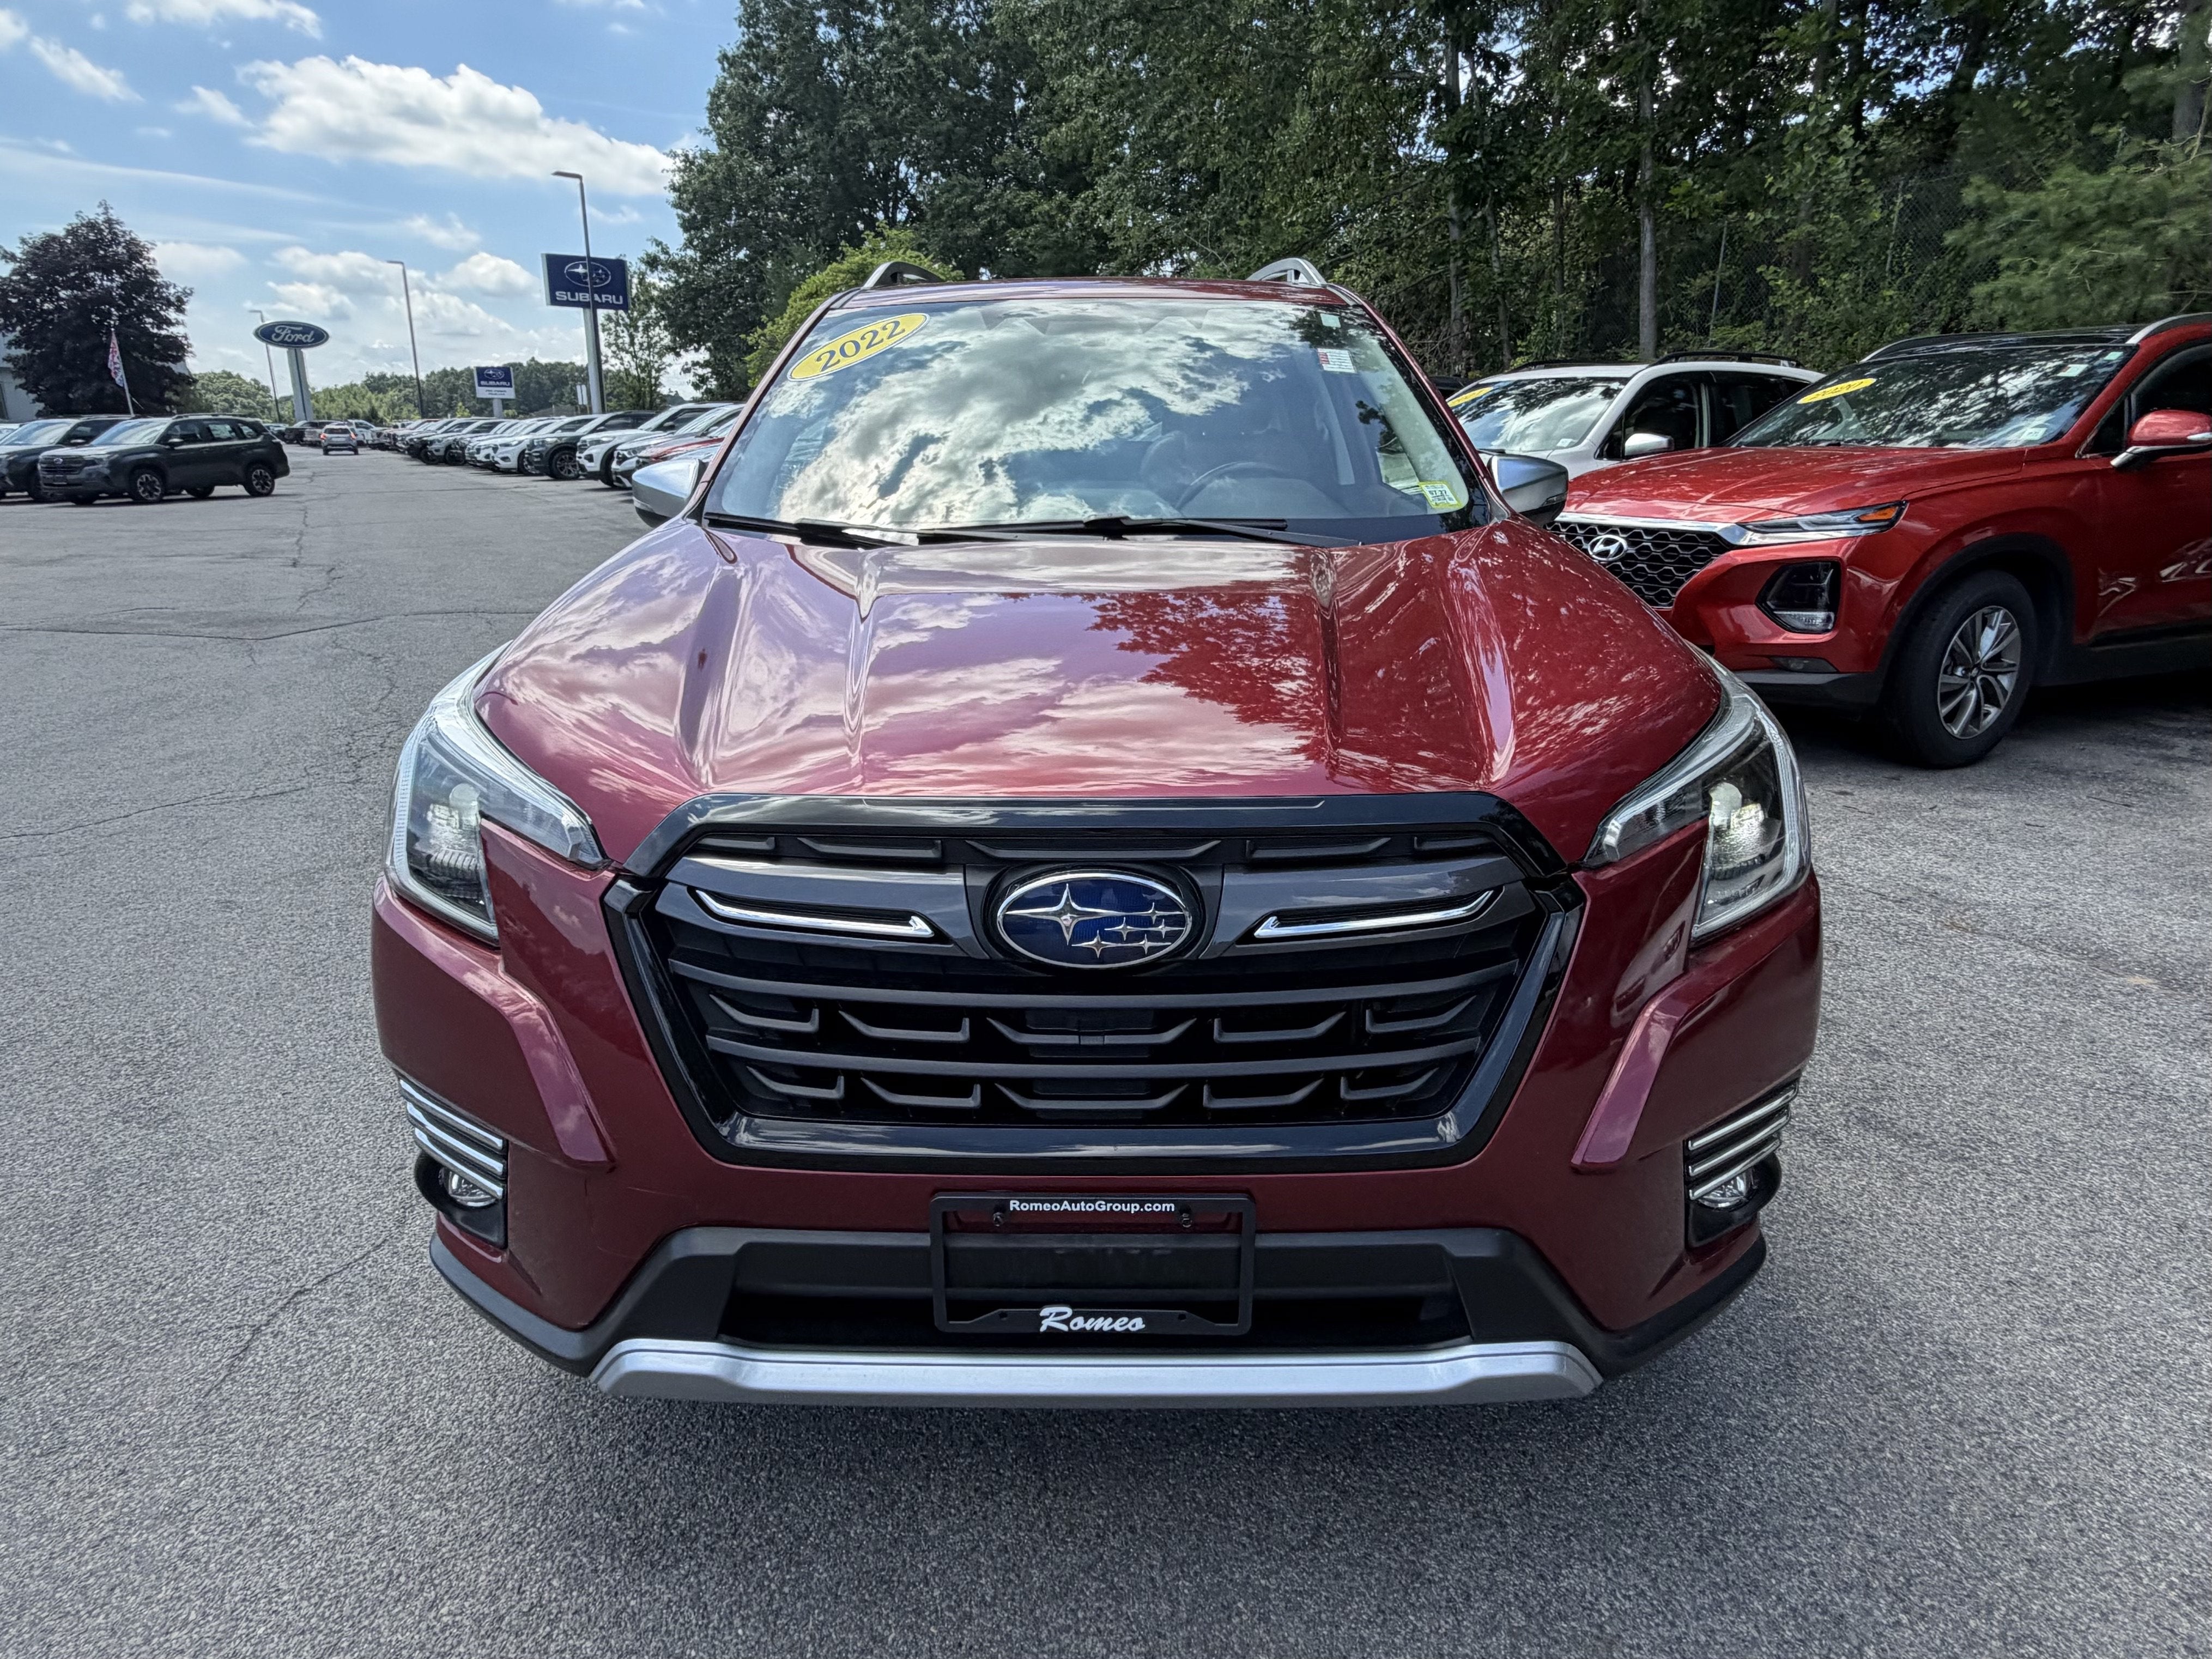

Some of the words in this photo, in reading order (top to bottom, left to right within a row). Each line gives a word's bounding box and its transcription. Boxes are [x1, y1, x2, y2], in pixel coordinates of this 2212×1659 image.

[556, 291, 623, 304] SUBARU
[271, 325, 314, 342] Ford
[816, 320, 905, 372] 2022
[1010, 1200, 1175, 1214] RomeoAutoGroup.com
[1039, 1306, 1146, 1332] Romeo
